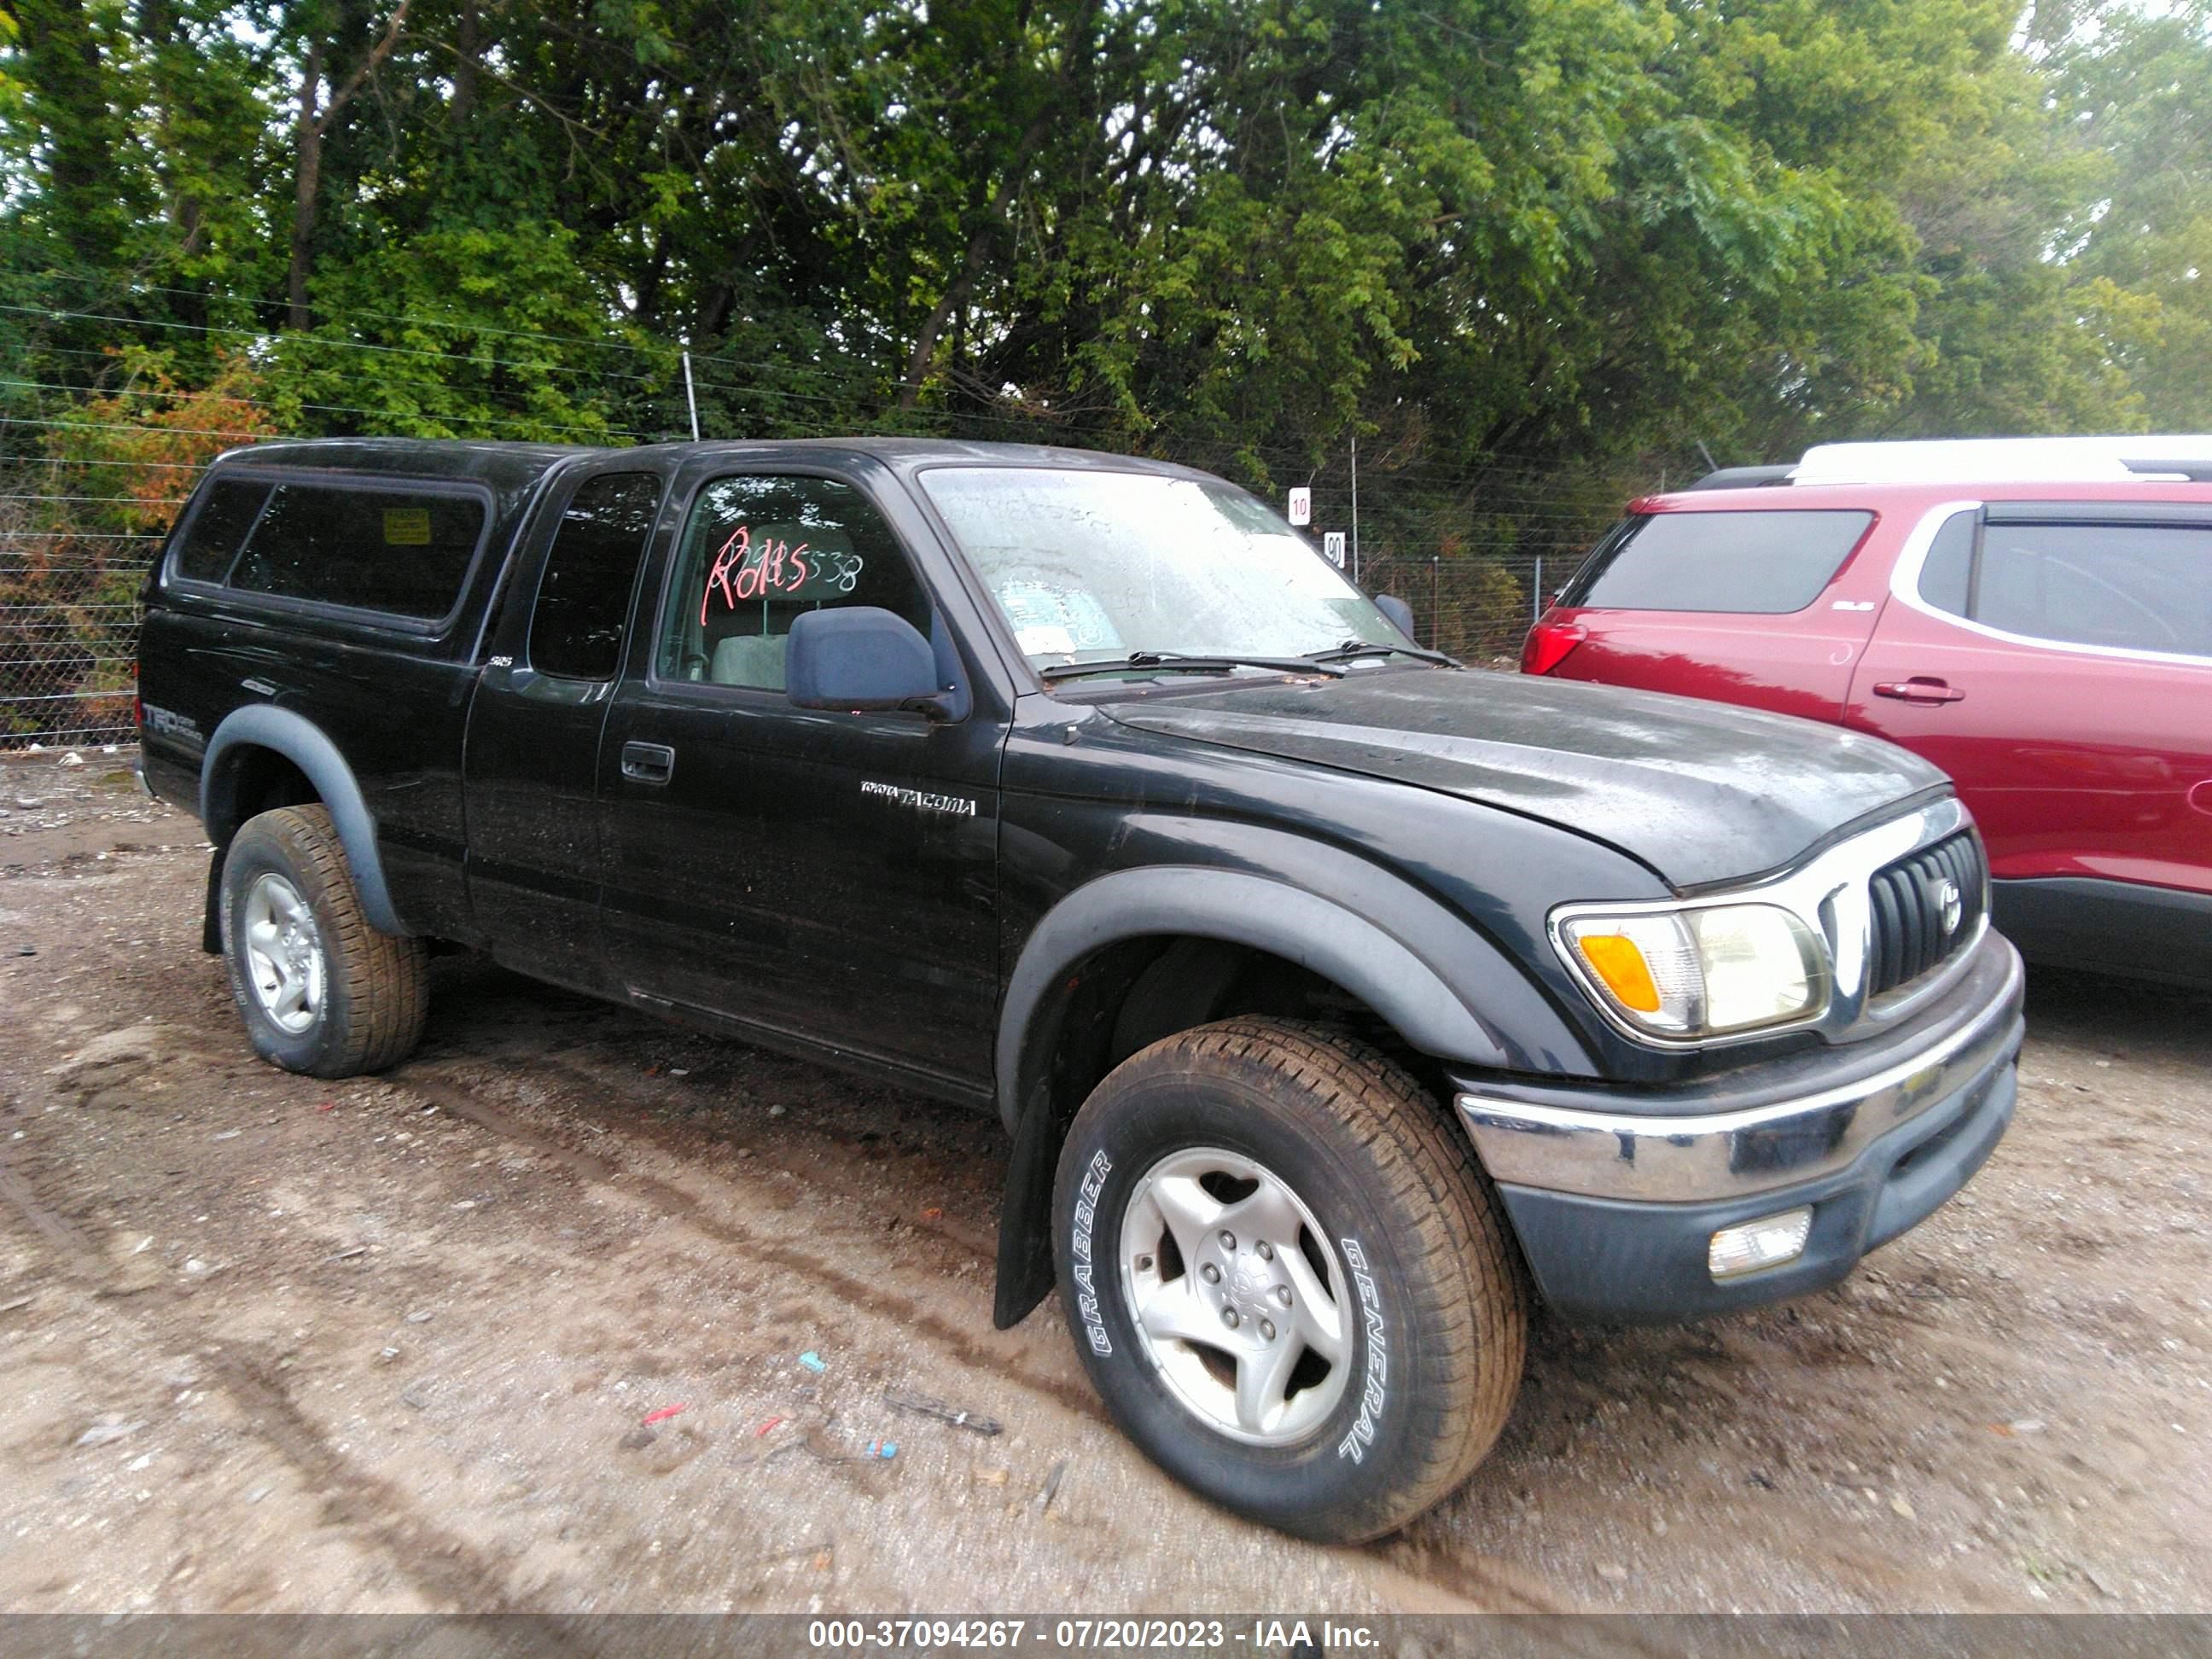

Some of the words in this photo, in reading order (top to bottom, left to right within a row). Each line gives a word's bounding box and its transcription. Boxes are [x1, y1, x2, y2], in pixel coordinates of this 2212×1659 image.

[1293, 498, 1307, 515] 10
[897, 789, 976, 817] TACOMA
[1073, 1150, 1112, 1358] GRABBER
[1339, 1237, 1388, 1465] GENERAL
